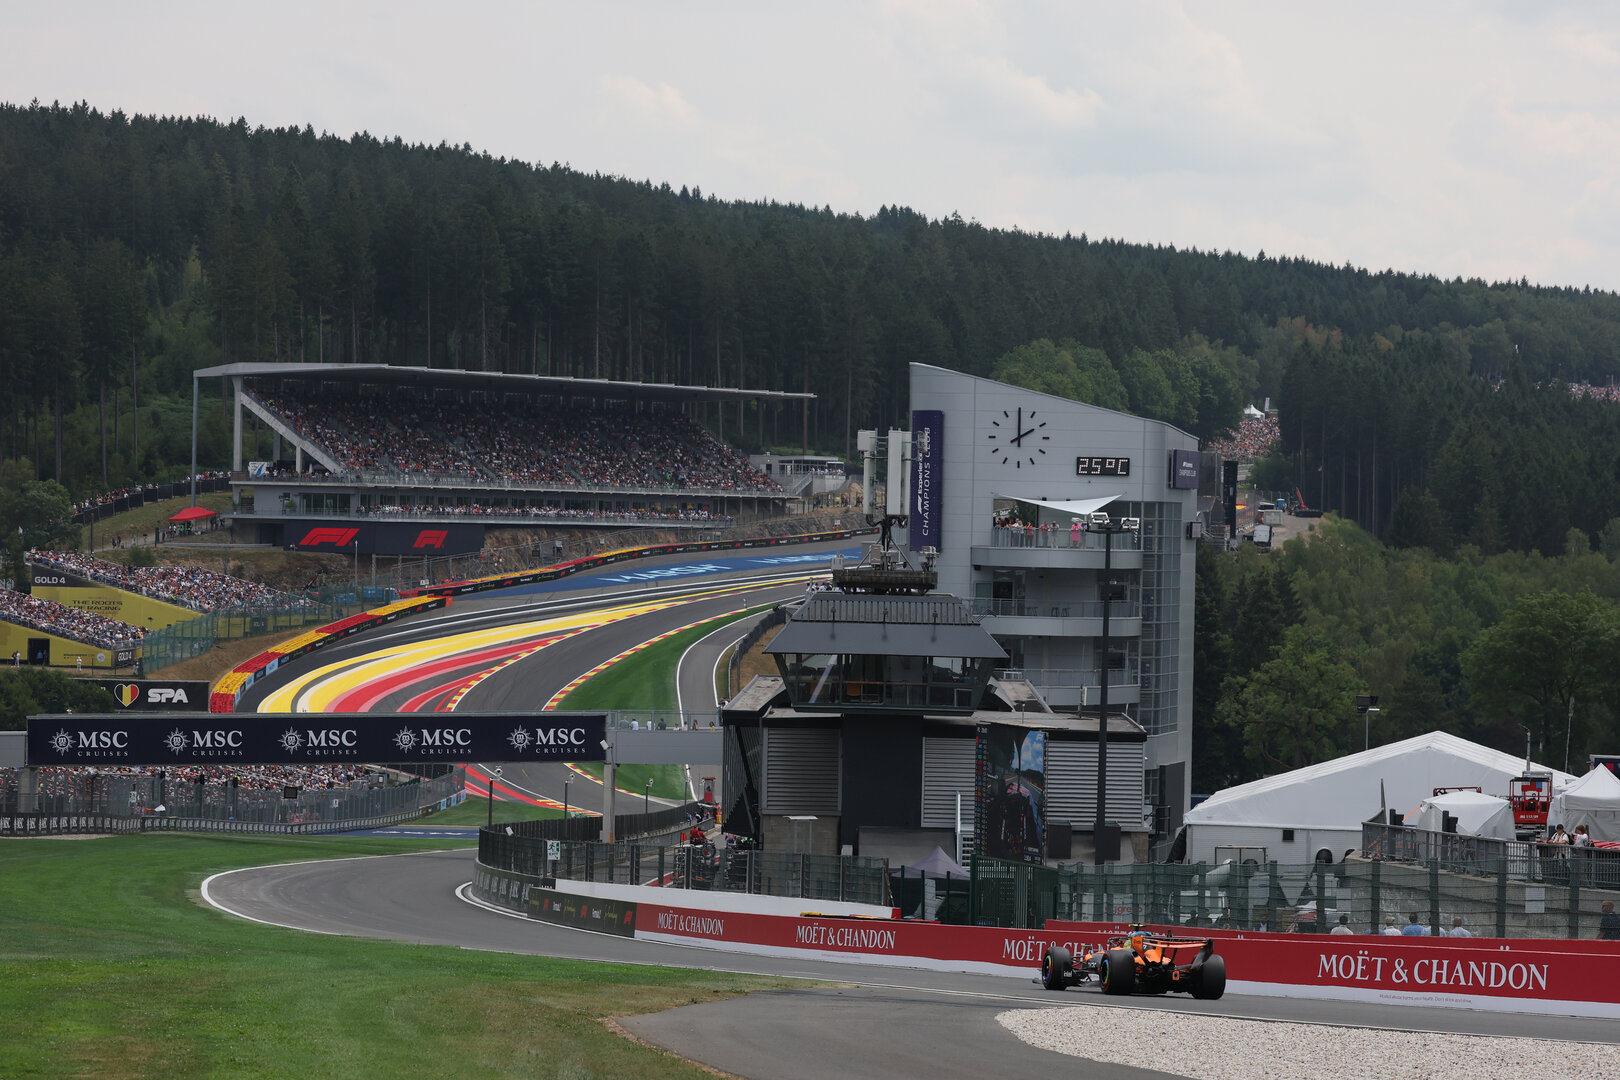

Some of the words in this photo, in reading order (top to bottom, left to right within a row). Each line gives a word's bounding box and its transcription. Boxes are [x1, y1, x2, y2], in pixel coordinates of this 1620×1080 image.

[923, 462, 931, 536] CHAMPIONS
[118, 651, 128, 661] GOLD
[148, 688, 188, 703] SPA
[78, 731, 128, 748] MSC
[193, 730, 242, 747] MSC
[307, 730, 357, 747] MSC
[421, 729, 471, 746] MSC
[536, 728, 585, 745] MSC
[657, 910, 679, 931] MOËT
[679, 916, 685, 930] &
[685, 916, 724, 936] CHANDON
[796, 923, 826, 944] MOËT
[827, 927, 835, 945] &
[837, 928, 896, 949] CHANDON
[1003, 936, 1046, 961] MOËT
[1317, 950, 1388, 981] MOËT
[1391, 958, 1409, 983] &
[1413, 959, 1549, 991] CHANDON
